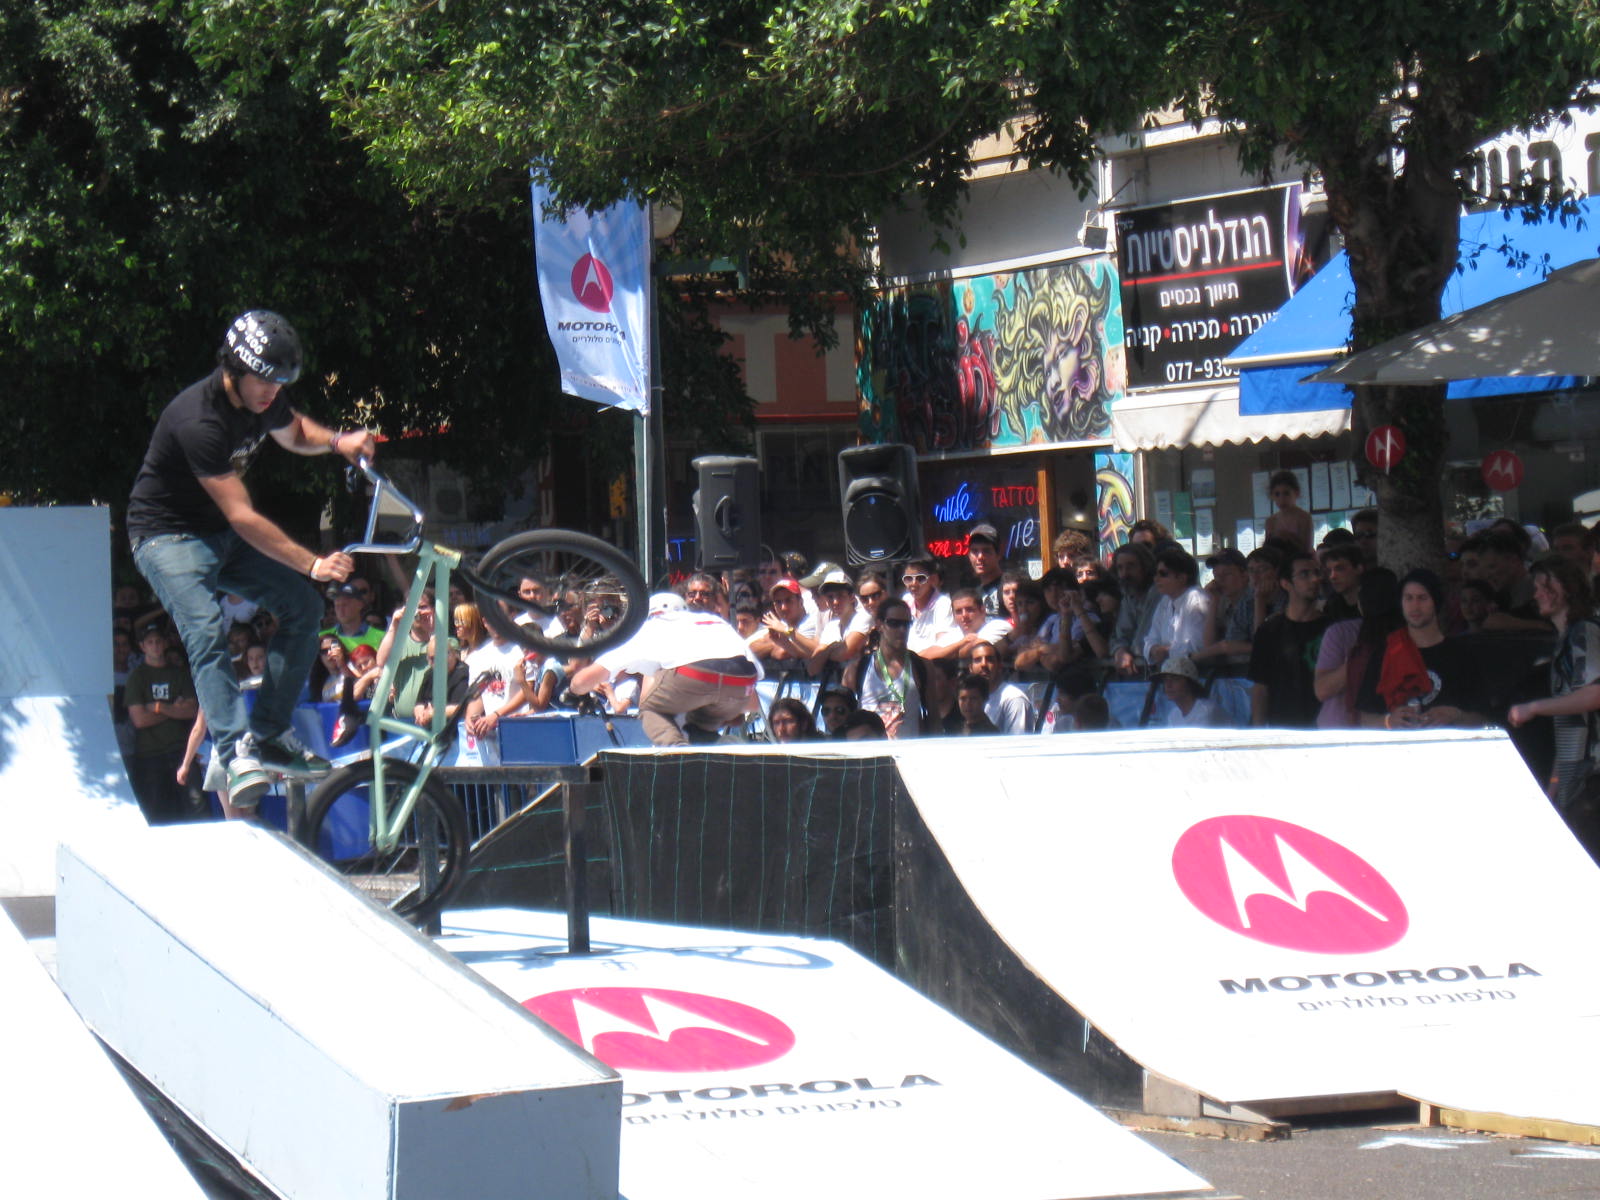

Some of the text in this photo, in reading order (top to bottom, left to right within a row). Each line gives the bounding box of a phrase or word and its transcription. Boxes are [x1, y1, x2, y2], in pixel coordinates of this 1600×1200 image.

[1127, 209, 1271, 273] הנדלניסטיות
[1160, 282, 1240, 308] תיווך נכסים
[1126, 311, 1279, 352] כרה מכירה קניה
[233, 344, 275, 377] MIKEY!
[991, 486, 1041, 508] TATTO
[1218, 962, 1543, 994] MOTOROLA
[1297, 988, 1517, 1012] טלפונים סלולריים
[622, 1074, 944, 1107] OTOROLA
[624, 1098, 903, 1125] טלפונים סלולריים
